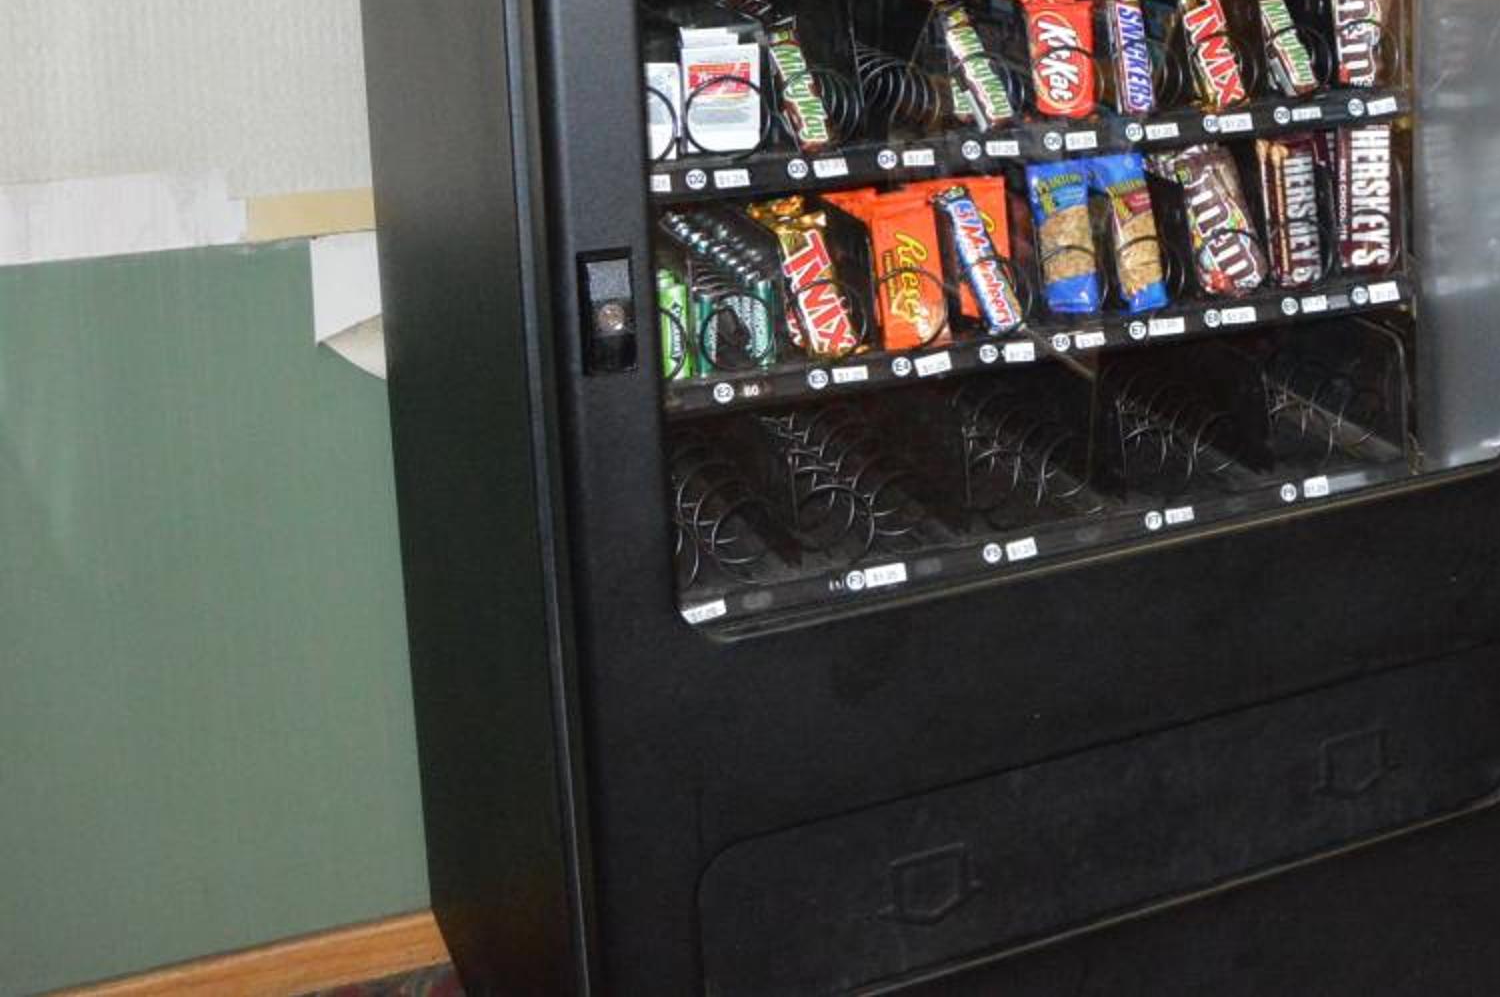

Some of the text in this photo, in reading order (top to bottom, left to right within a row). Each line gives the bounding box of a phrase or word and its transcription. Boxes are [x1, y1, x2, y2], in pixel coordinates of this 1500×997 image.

[1117, 6, 1154, 108] SNICKERS
[1351, 127, 1391, 267] HERSHEY'S
[782, 229, 857, 354] TWIX
